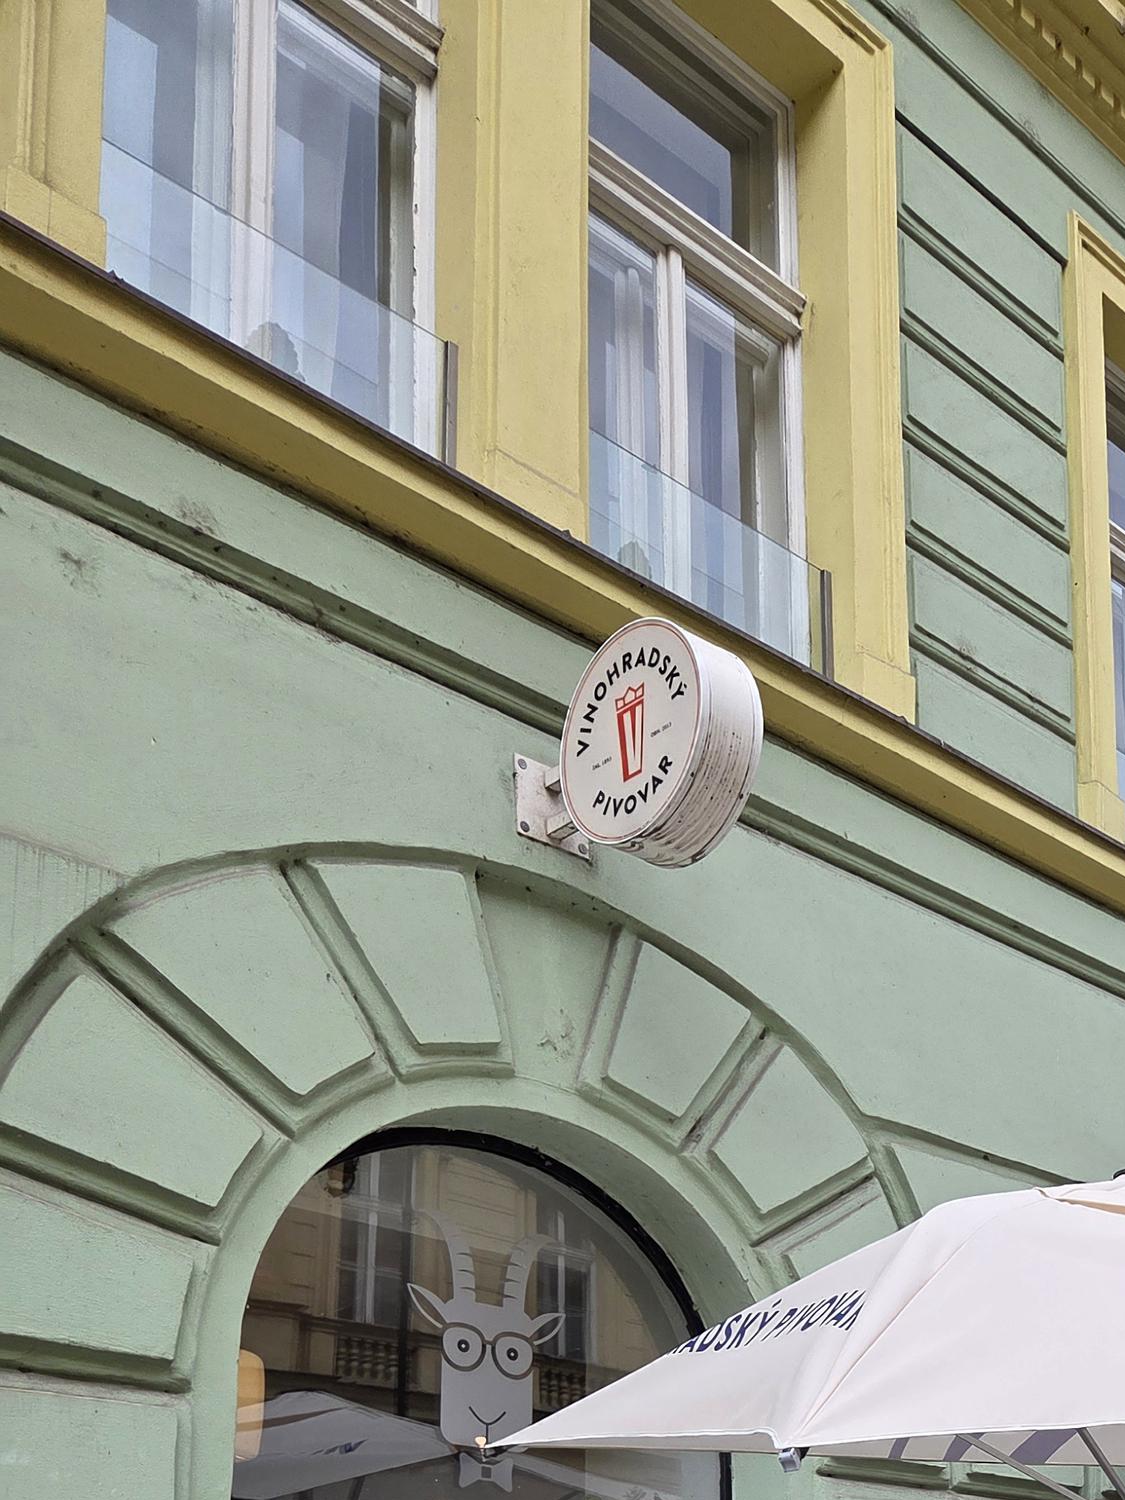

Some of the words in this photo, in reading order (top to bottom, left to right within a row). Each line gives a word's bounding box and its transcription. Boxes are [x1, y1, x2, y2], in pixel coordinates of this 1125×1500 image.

[576, 647, 687, 757] VINOHRADSKÝ
[592, 755, 673, 817] PIVOVAR
[672, 1298, 782, 1354] ADSKÝ
